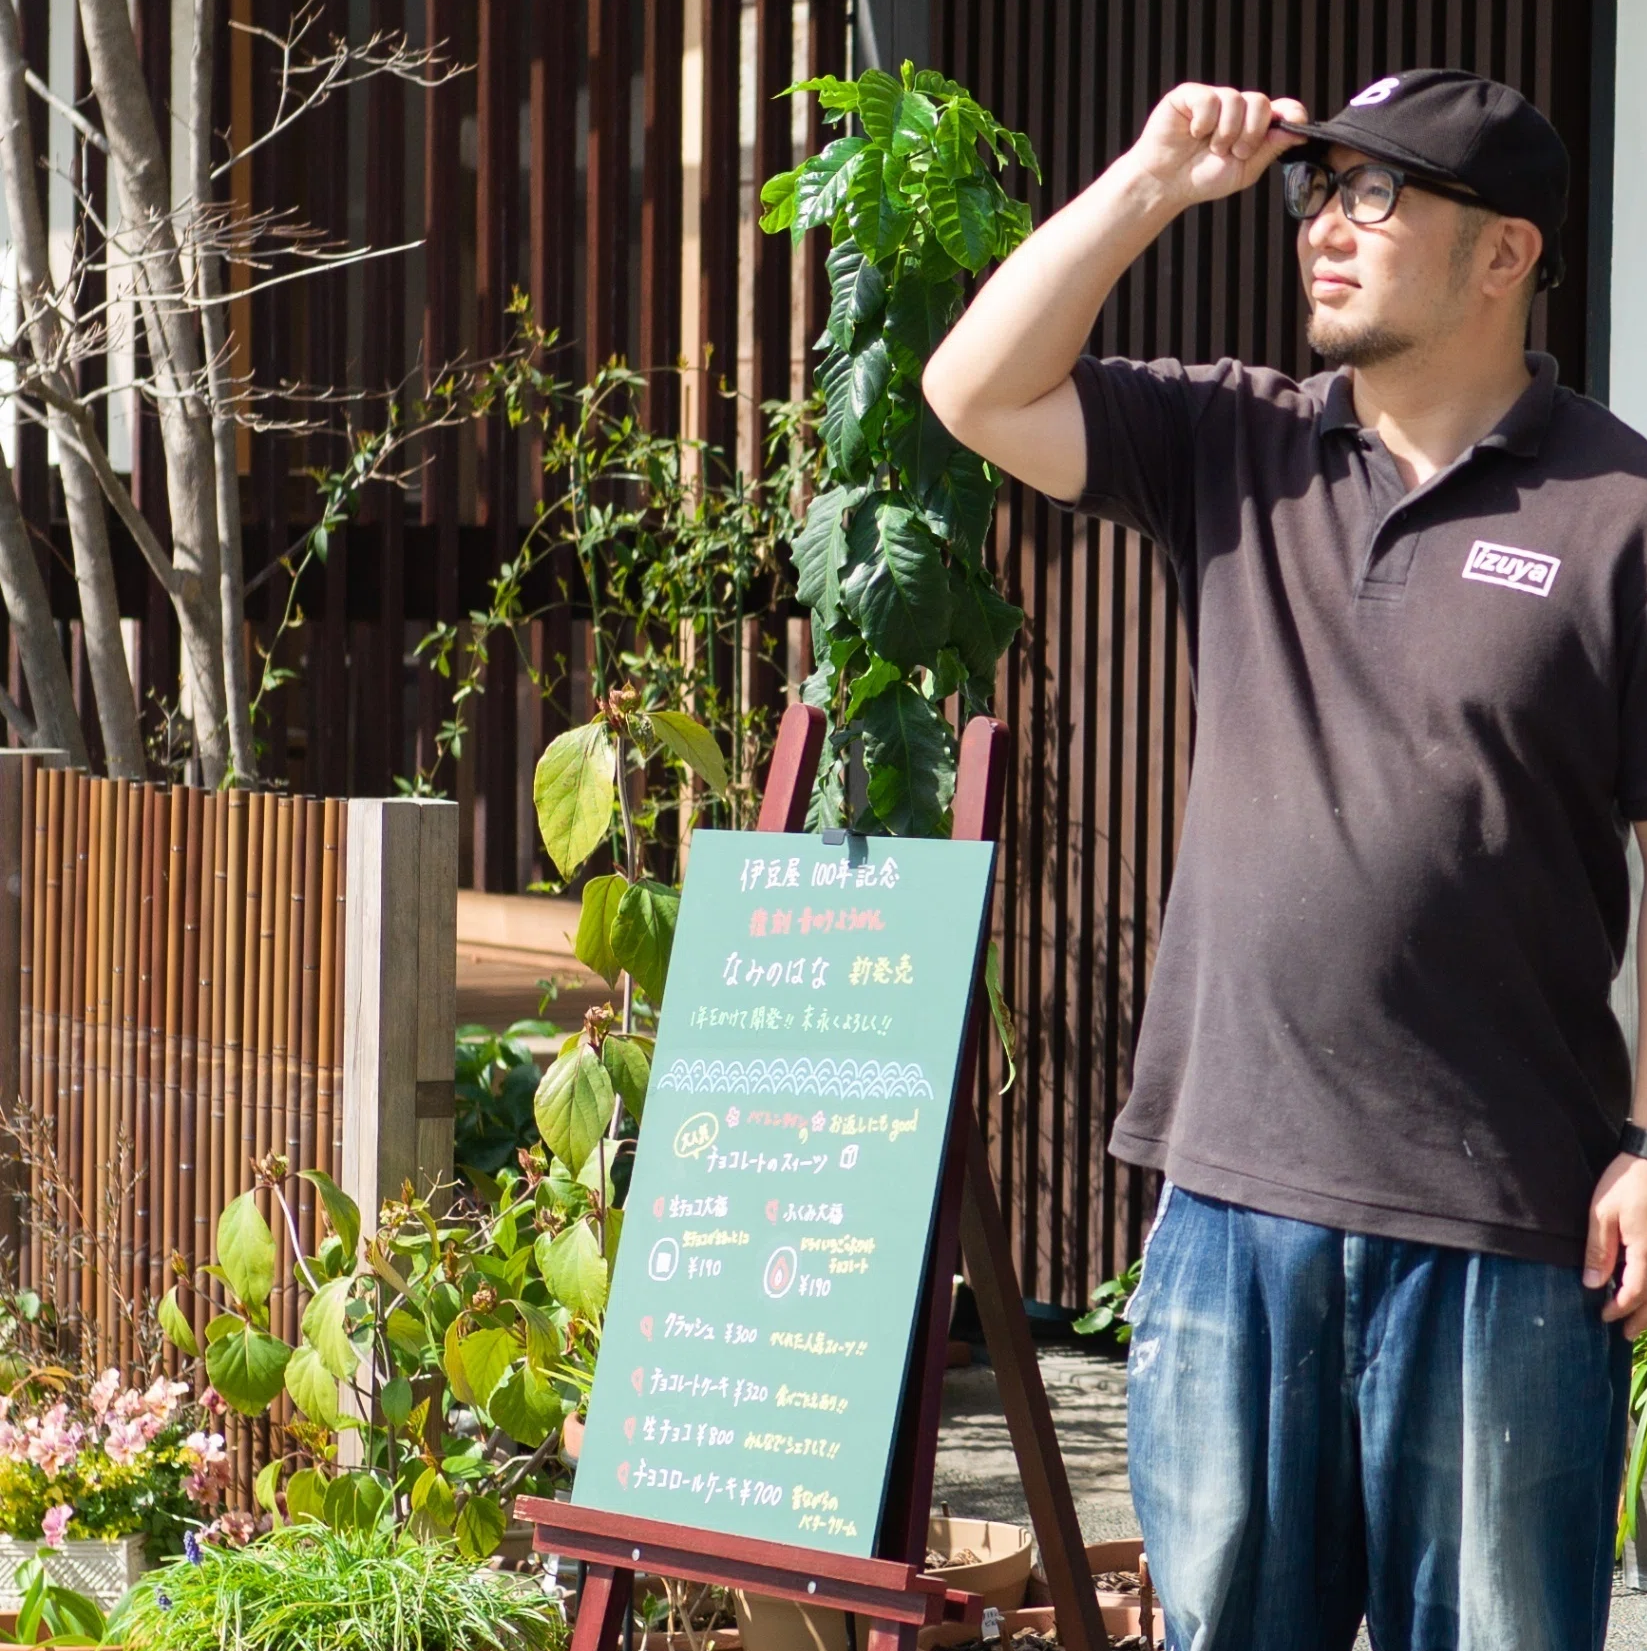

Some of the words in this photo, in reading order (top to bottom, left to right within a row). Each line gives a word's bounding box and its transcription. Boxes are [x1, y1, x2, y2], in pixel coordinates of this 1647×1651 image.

[740, 857, 801, 892] 伊豆屋
[723, 951, 830, 989] なみのはな
[849, 953, 914, 986] 新発売
[669, 1194, 729, 1219] 生チョコ大福
[687, 1255, 722, 1280] ¥190
[799, 1274, 831, 1297] ¥190
[664, 1312, 715, 1339] クラッシュ
[724, 1322, 758, 1345] ¥300
[650, 1367, 729, 1398] チョコレートケーキ
[733, 1378, 769, 1407] ¥320
[642, 1415, 692, 1445] 生チョコ
[696, 1423, 734, 1447] ¥800
[633, 1457, 738, 1505] チョコロールケーキ
[739, 1479, 783, 1507] ¥700
